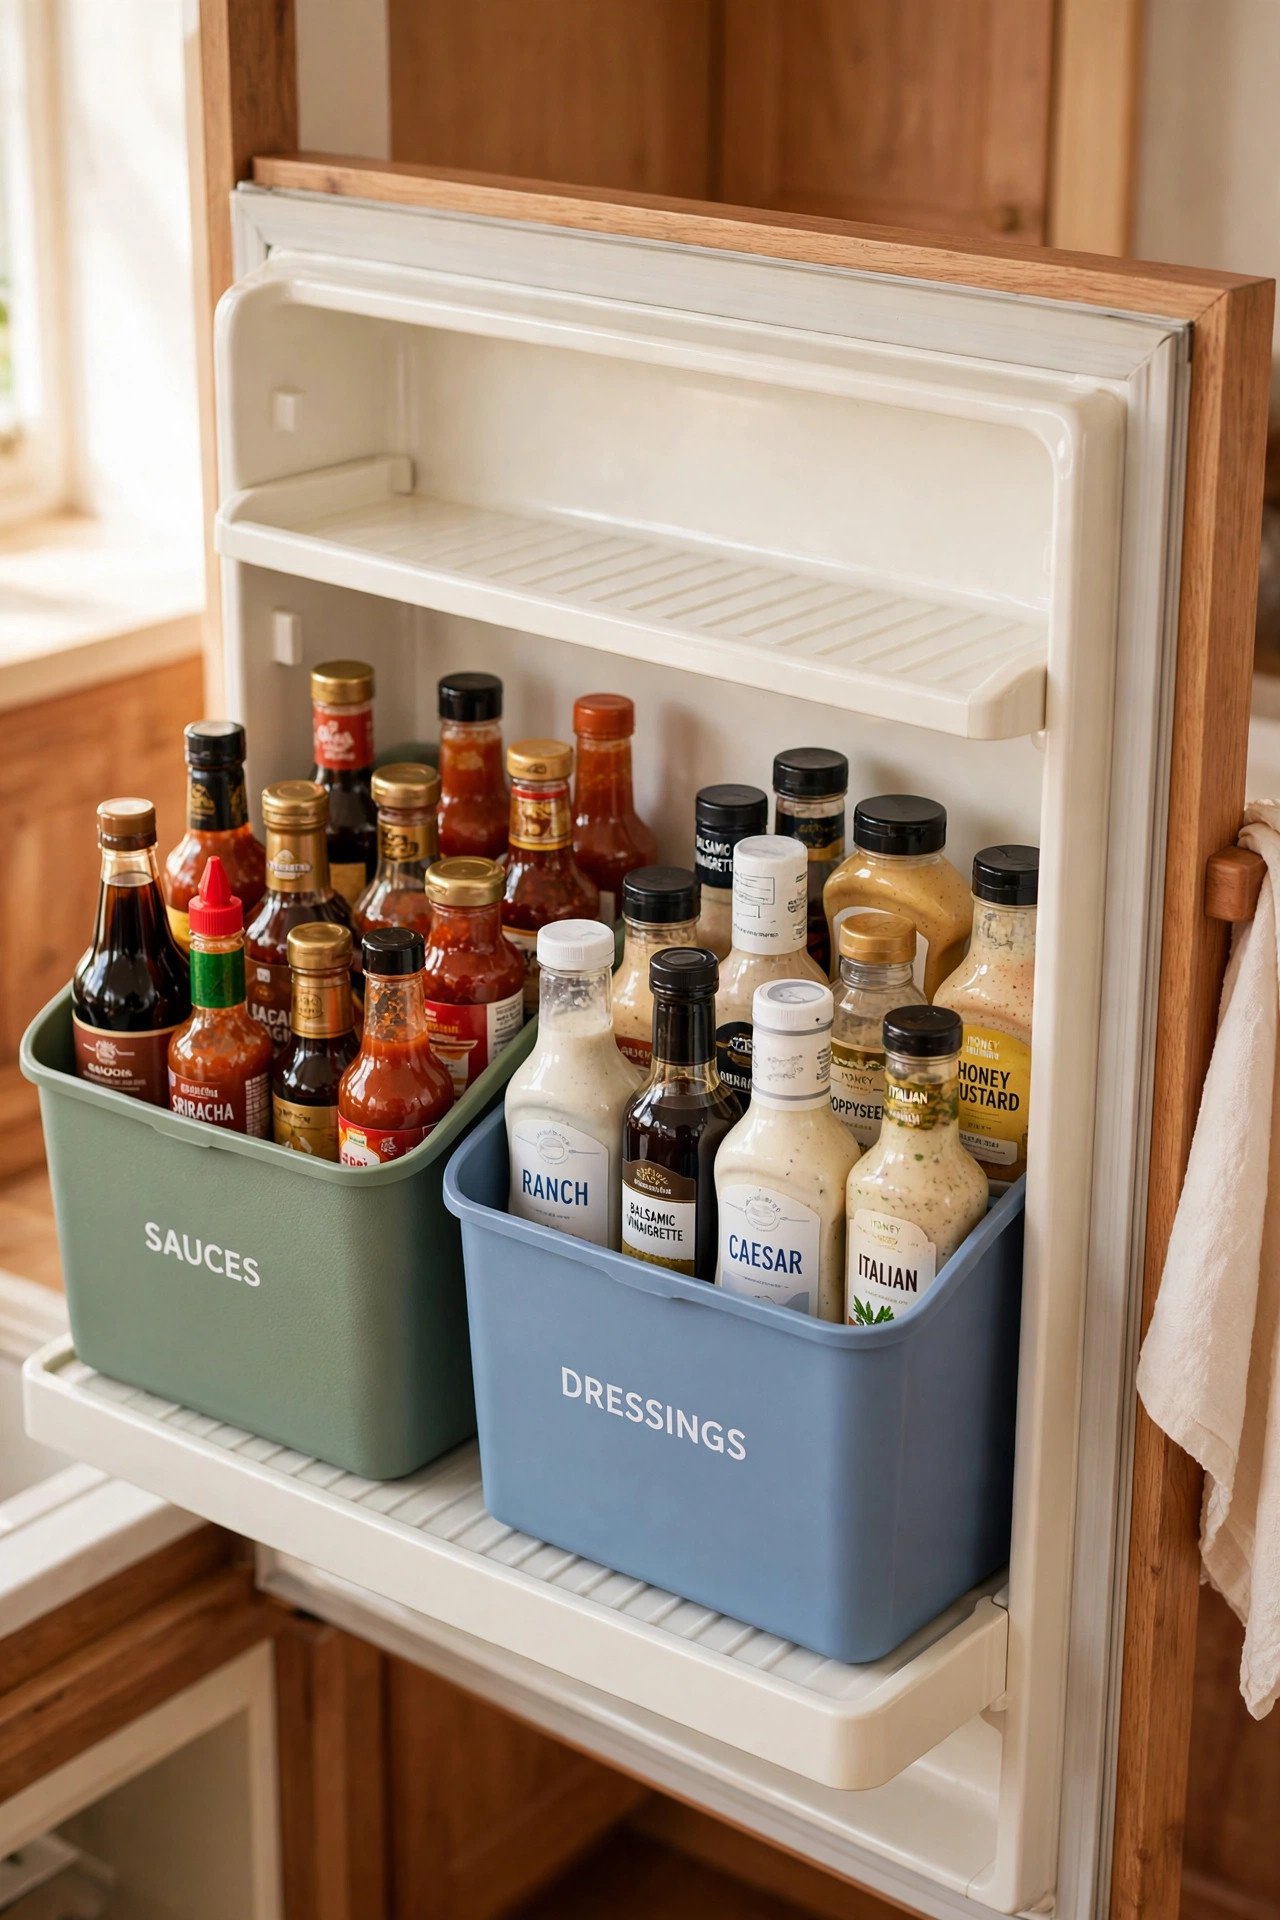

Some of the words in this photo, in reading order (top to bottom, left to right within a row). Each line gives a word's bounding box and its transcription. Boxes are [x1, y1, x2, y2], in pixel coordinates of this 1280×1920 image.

[958, 1060, 1010, 1089] HONEY
[172, 1095, 234, 1121] SRIRACHA
[830, 1095, 884, 1120] OPPYSEE
[959, 1081, 1019, 1111] USTARD
[522, 1168, 589, 1206] RANCH
[626, 1213, 684, 1242] VINAIGRETTE
[630, 1201, 676, 1227] BALSAMIC
[144, 1221, 261, 1287] SAUCES
[729, 1234, 802, 1275] CAESAR
[859, 1253, 918, 1292] ITALIAN
[561, 1366, 747, 1461] DRESSINGS
